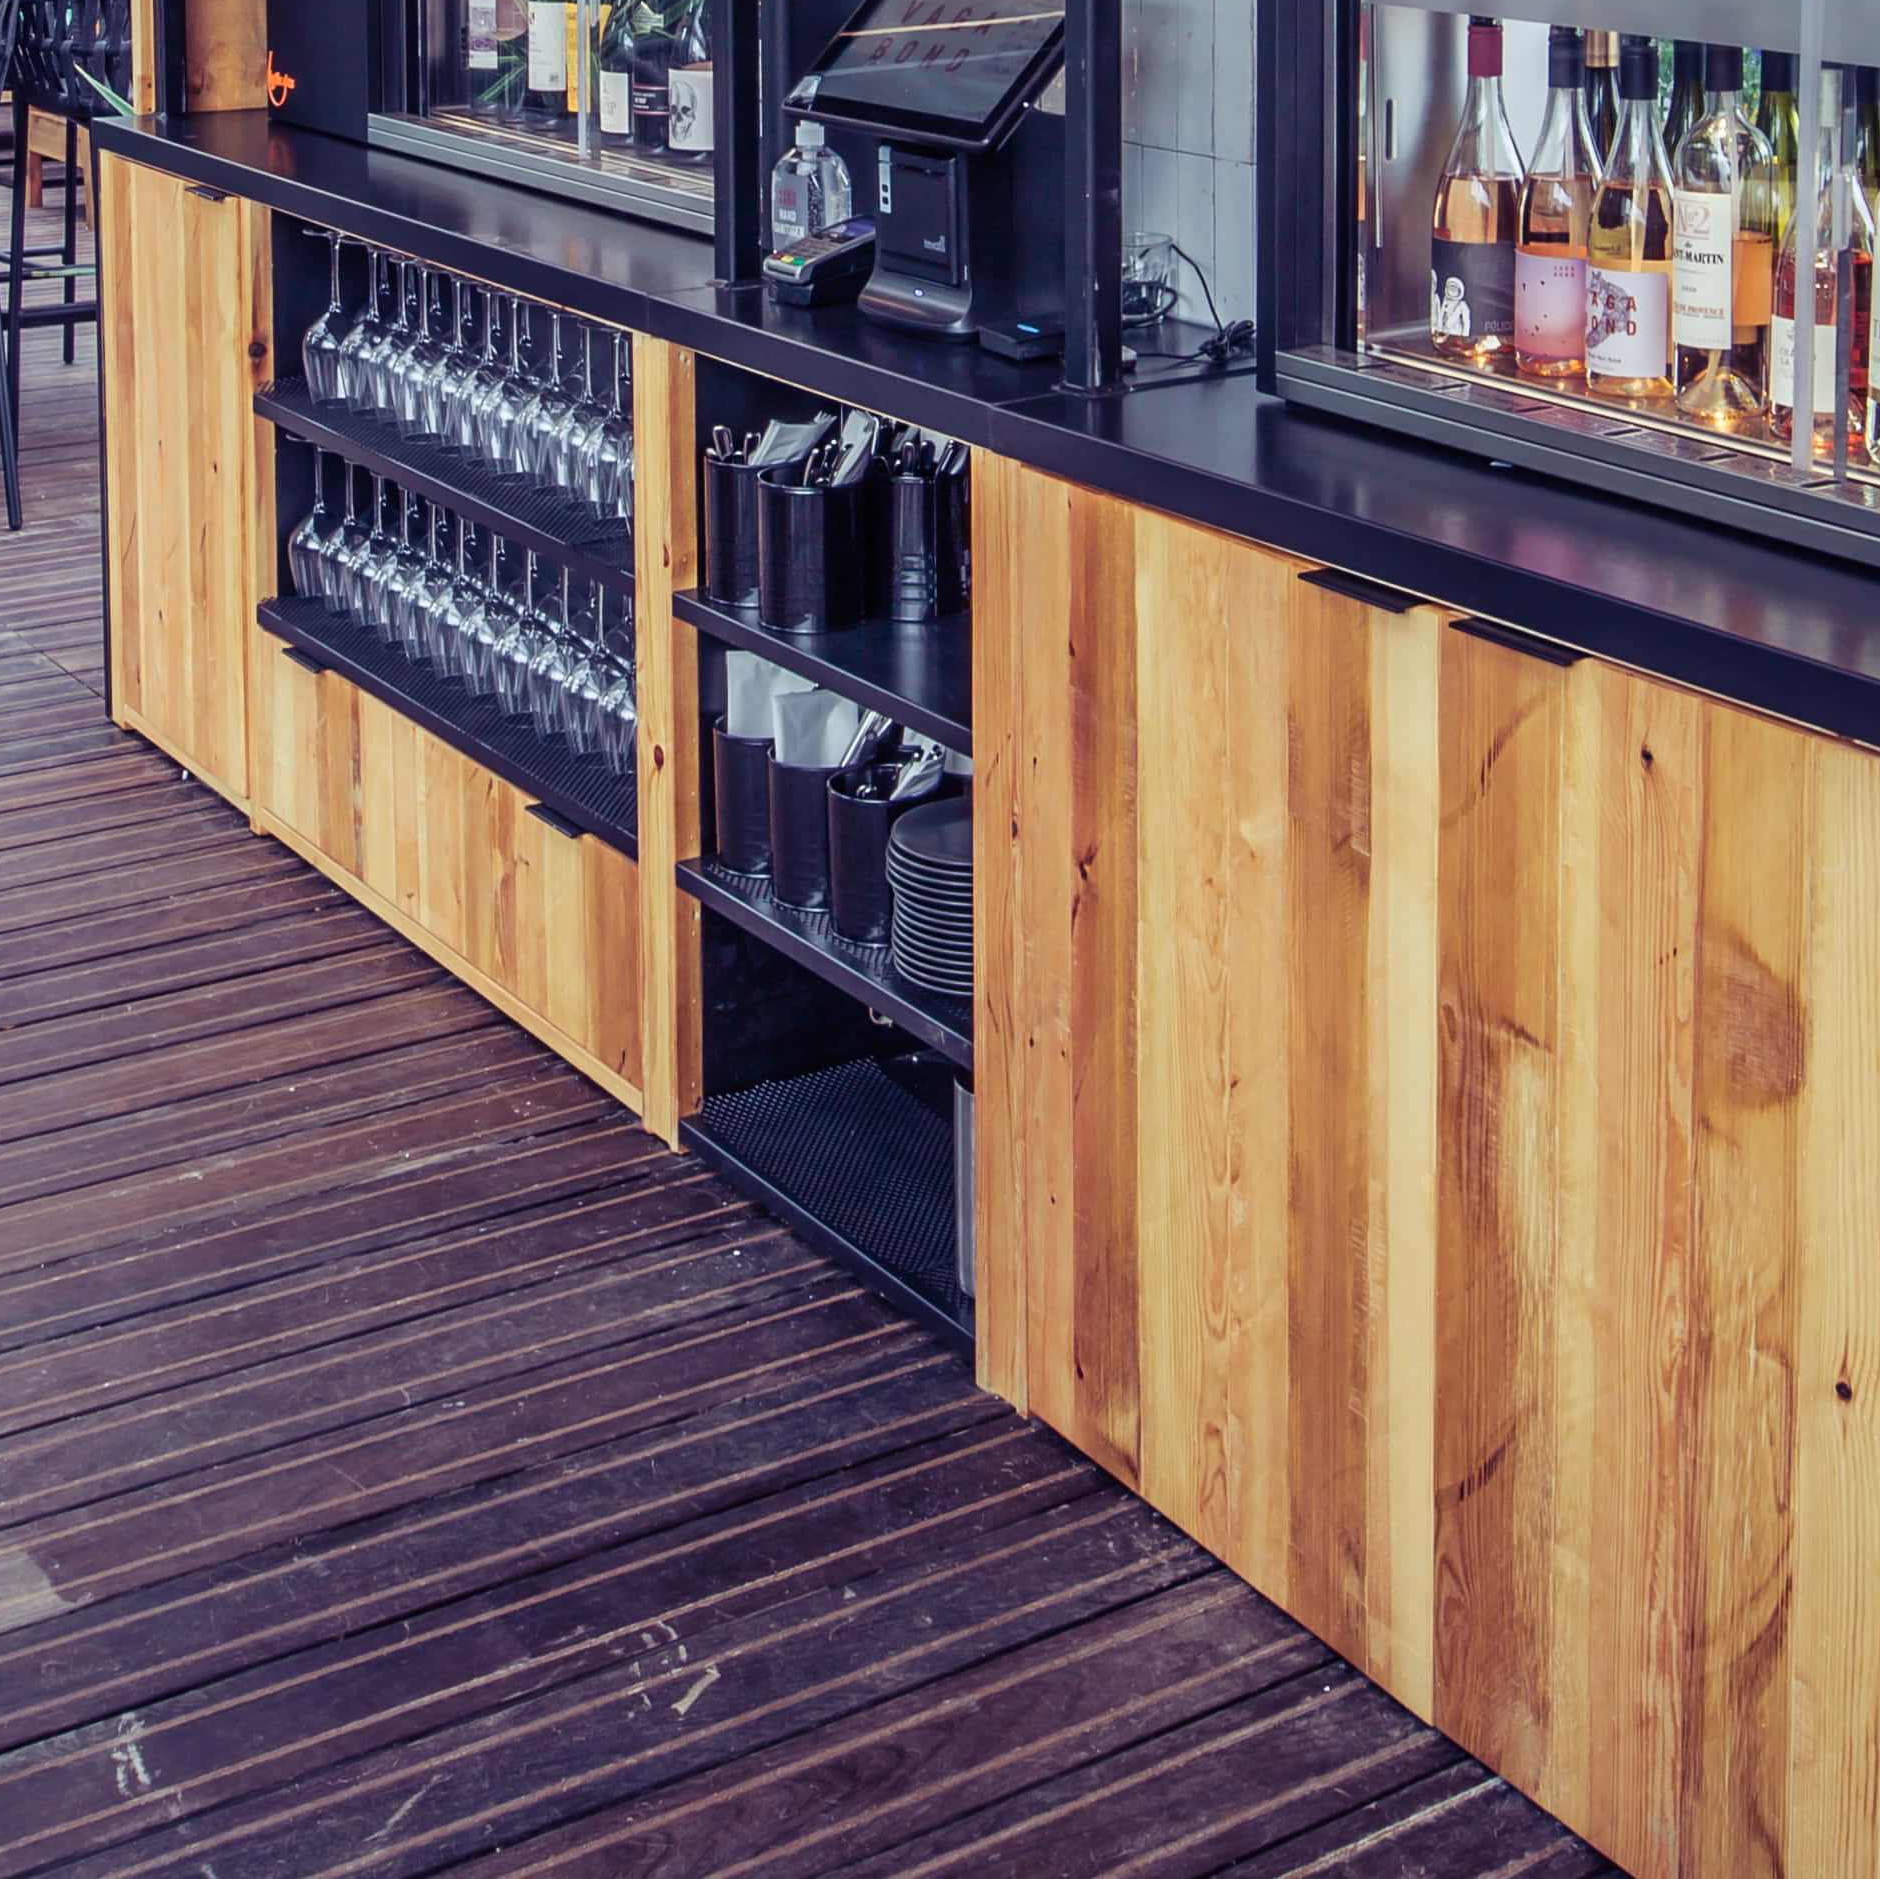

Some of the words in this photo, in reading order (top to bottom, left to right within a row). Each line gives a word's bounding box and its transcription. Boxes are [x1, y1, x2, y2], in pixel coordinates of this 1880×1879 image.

[901, 0, 998, 36] VAGA
[868, 36, 971, 72] BOND
[1590, 291, 1638, 313] AGA
[1590, 314, 1638, 337] OND
